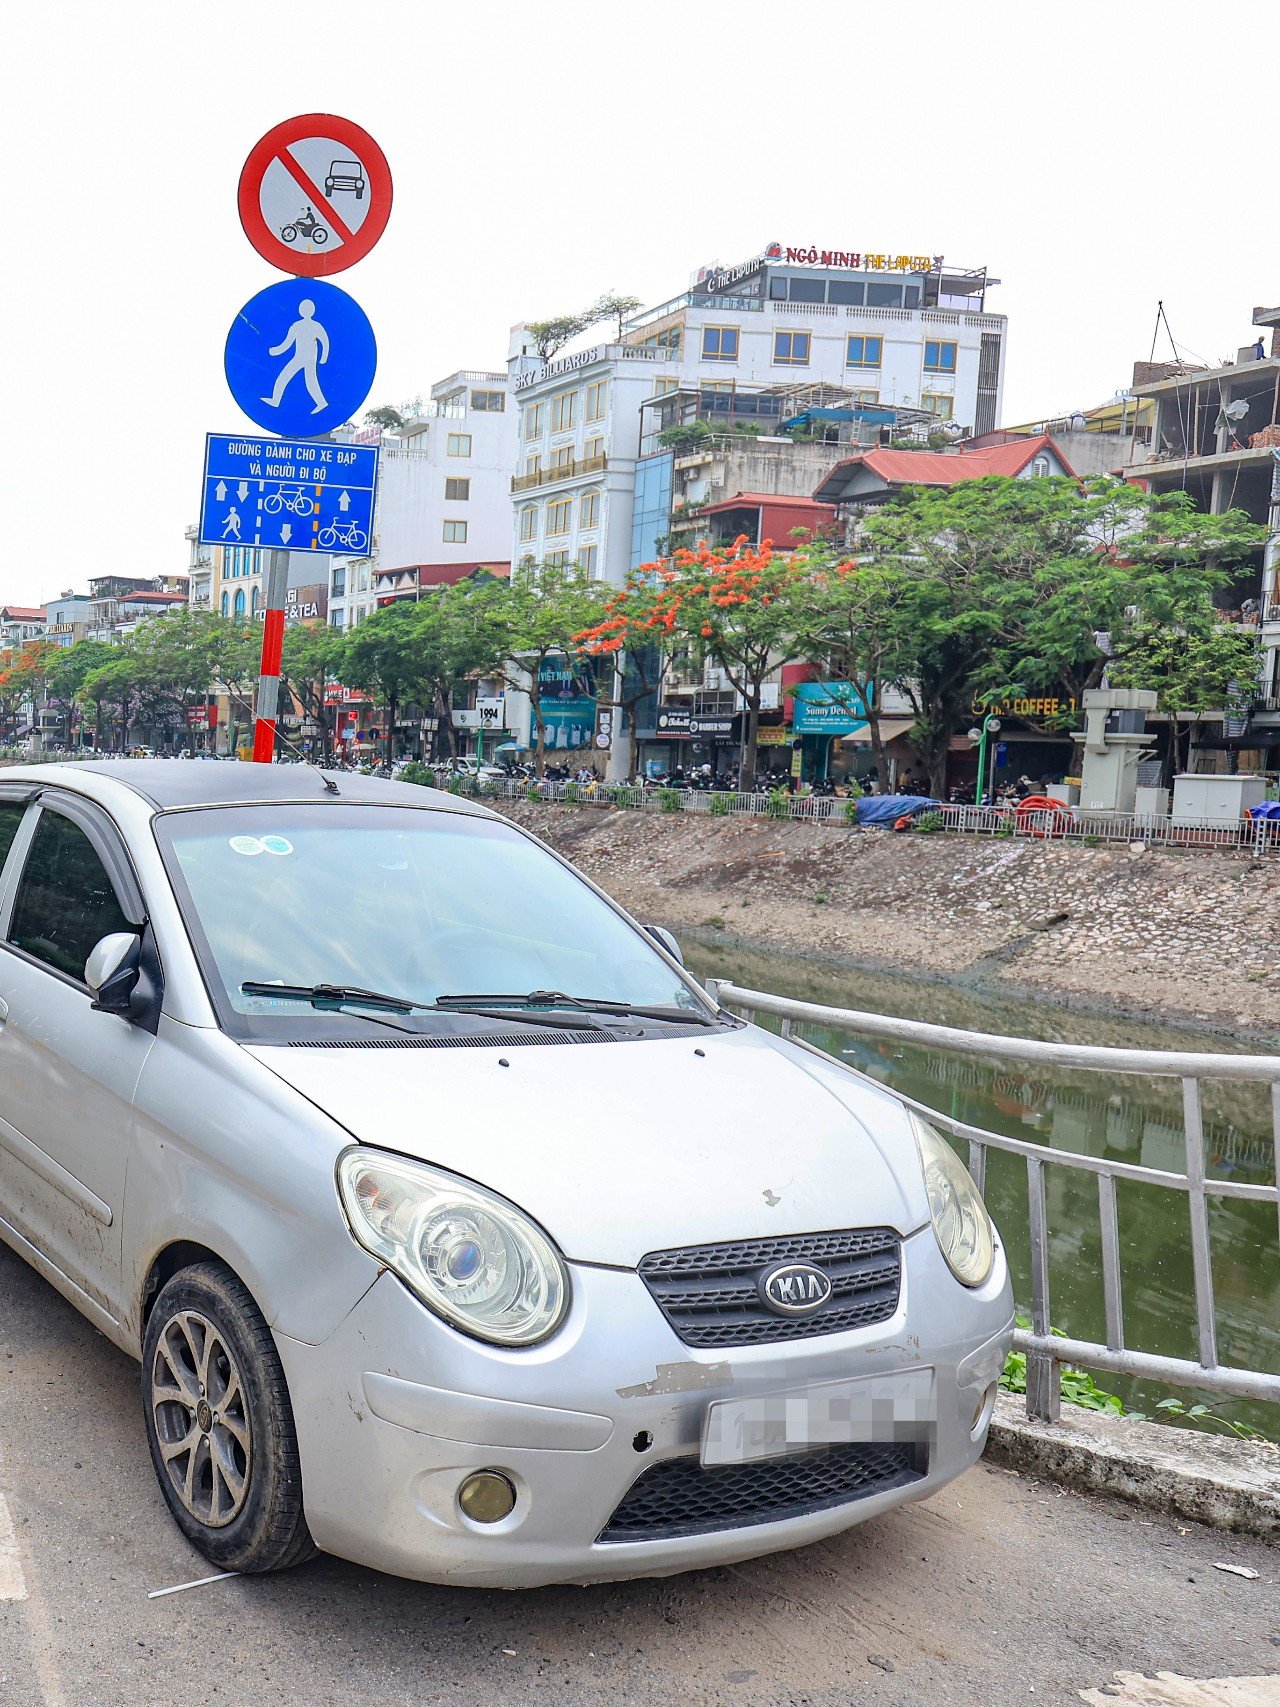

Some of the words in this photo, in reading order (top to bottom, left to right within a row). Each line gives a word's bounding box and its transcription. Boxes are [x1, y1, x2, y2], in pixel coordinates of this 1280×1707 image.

[786, 246, 818, 263] NGÔ
[821, 250, 861, 267] MINH
[865, 253, 885, 270] THE
[887, 255, 931, 272] LAPUTA
[718, 271, 730, 288] THE
[731, 257, 761, 282] LAPUTA
[515, 370, 536, 388] SKY
[540, 347, 598, 380] BILLIARDS
[228, 440, 261, 457] ĐƯỜNG
[265, 443, 292, 459] DÀNH
[296, 448, 315, 461] CHO
[320, 450, 333, 462] XE
[337, 451, 357, 466] ĐẠP
[249, 460, 261, 475] VÀ
[266, 462, 295, 478] NGƯỜI
[299, 467, 309, 479] ĐI
[313, 466, 327, 482] BỘ
[480, 708, 498, 719] 1994
[805, 706, 829, 717] Sunny
[830, 706, 857, 715] Denl
[1013, 698, 1059, 715] COFFEE
[776, 1276, 824, 1302] KIA
